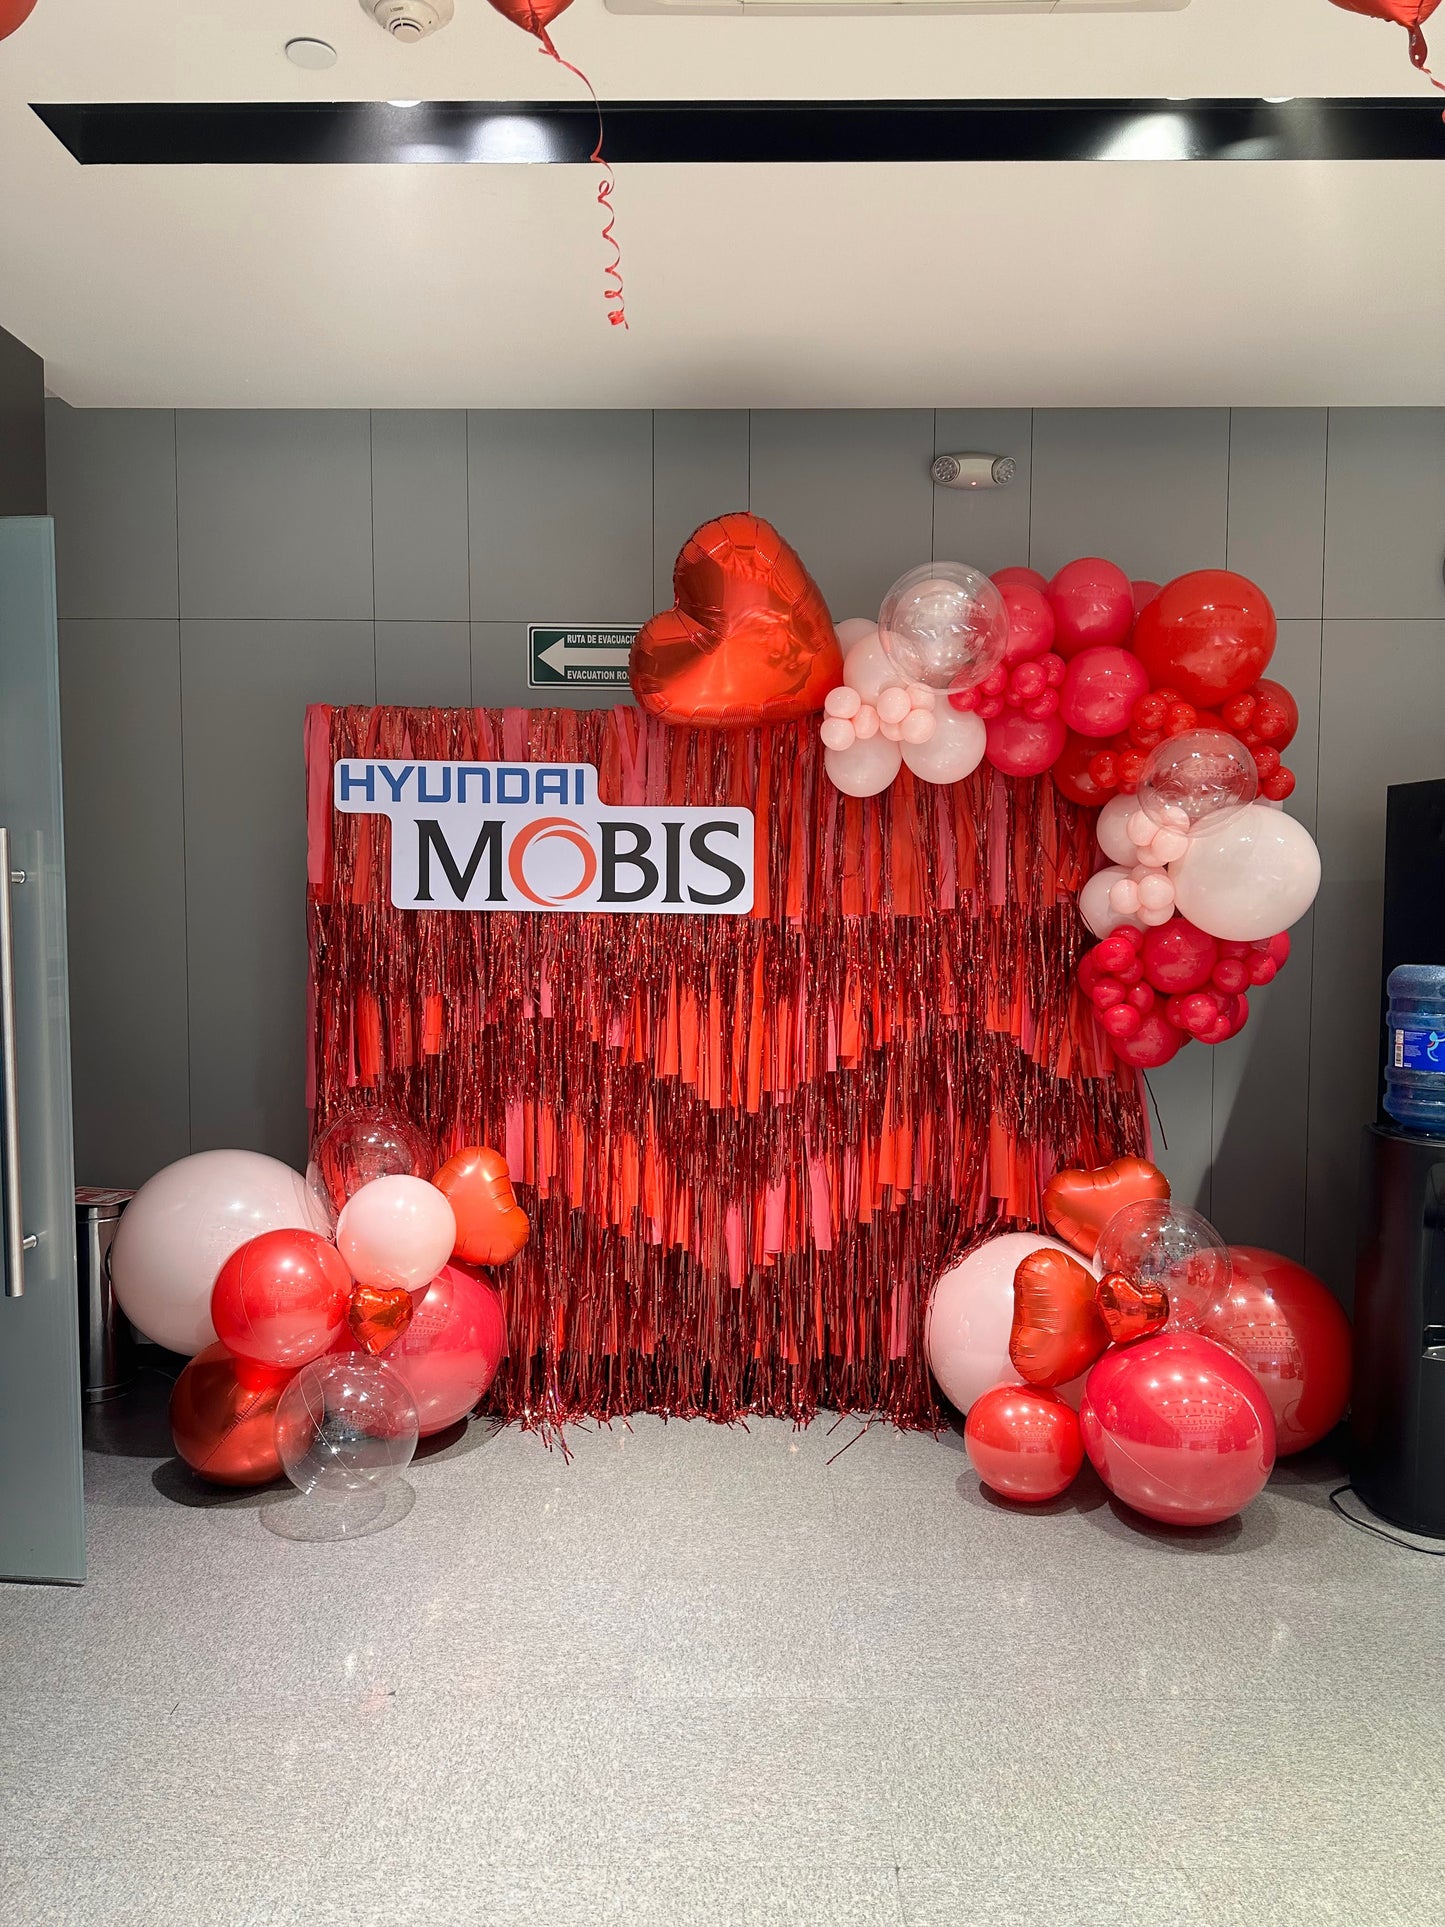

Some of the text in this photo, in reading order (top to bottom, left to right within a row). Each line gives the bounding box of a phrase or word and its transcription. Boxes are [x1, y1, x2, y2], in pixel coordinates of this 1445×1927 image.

[567, 634, 586, 644] RUTA
[587, 634, 597, 644] DE
[567, 670, 630, 680] EVACUATION RO
[340, 764, 584, 805] HYUNDAI
[413, 816, 746, 907] MOBIS
